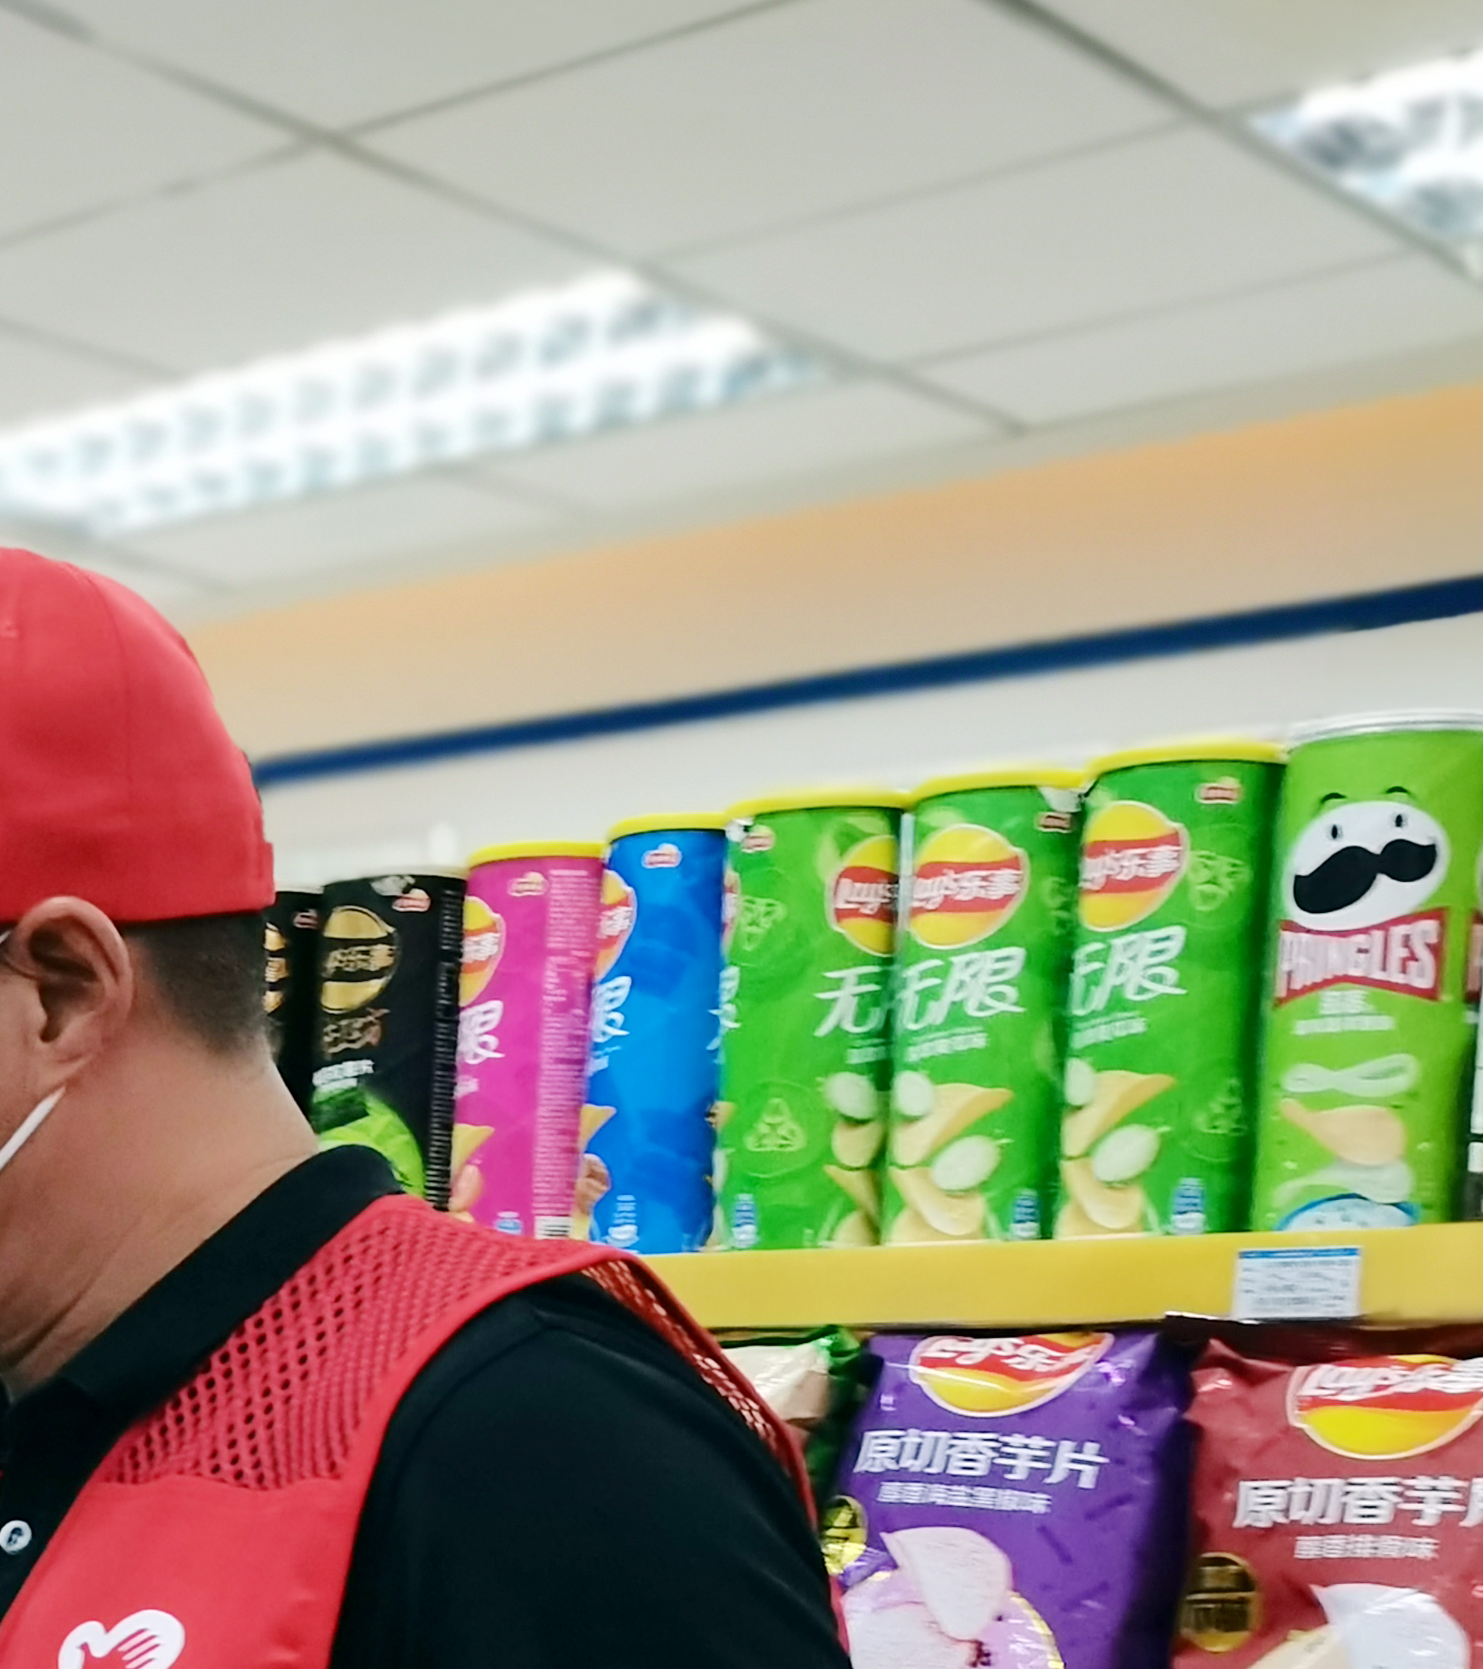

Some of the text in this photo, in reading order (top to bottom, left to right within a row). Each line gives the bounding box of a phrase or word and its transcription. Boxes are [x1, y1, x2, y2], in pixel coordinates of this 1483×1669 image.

[1275, 918, 1440, 998] PRINGLES
[852, 1428, 1111, 1490] 原切香芋片
